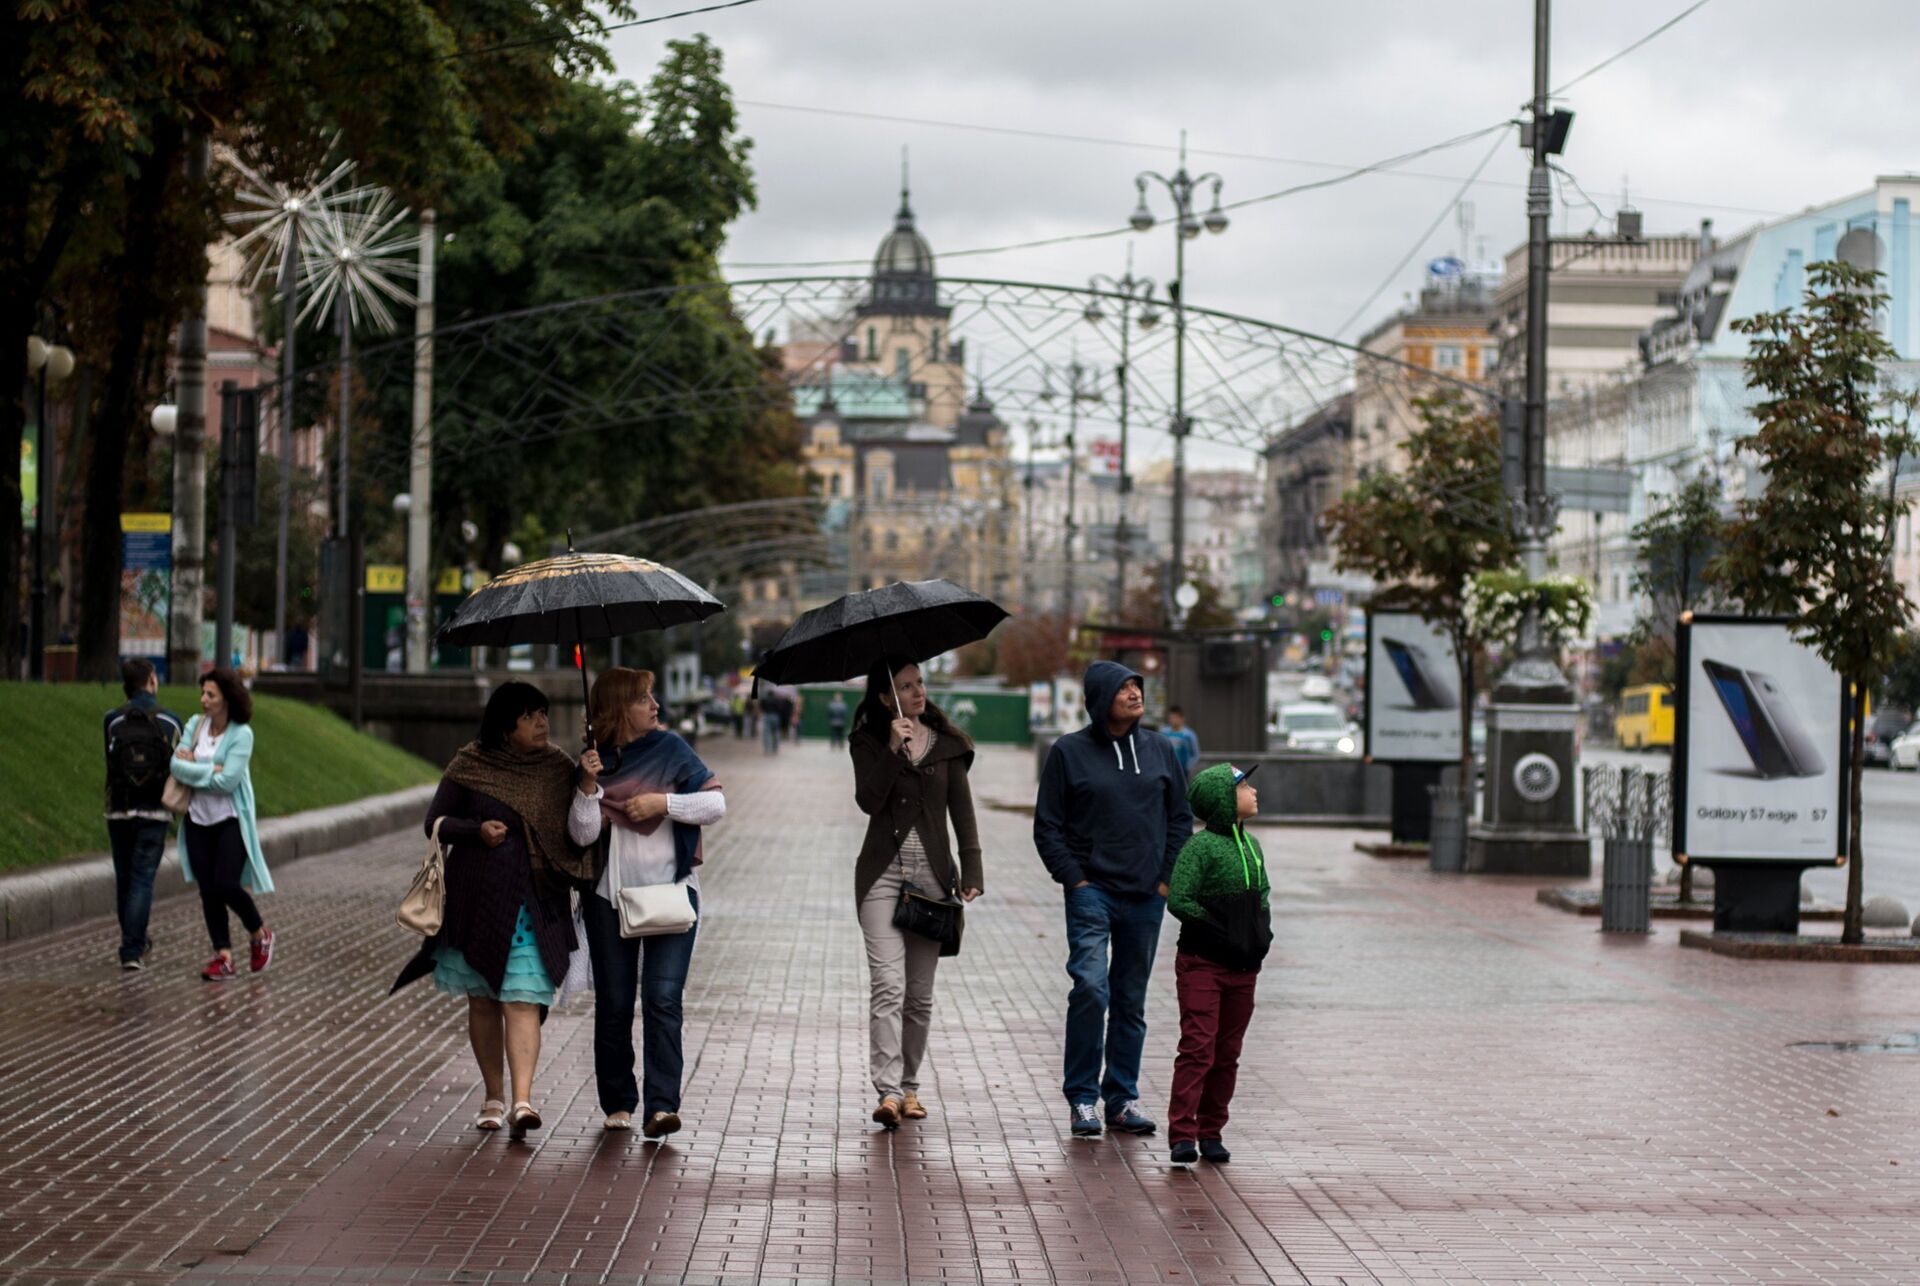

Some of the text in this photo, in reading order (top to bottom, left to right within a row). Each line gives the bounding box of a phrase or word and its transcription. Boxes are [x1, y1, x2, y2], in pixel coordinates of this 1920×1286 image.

[1697, 807, 1828, 823] Galaxy S7 edge S7
